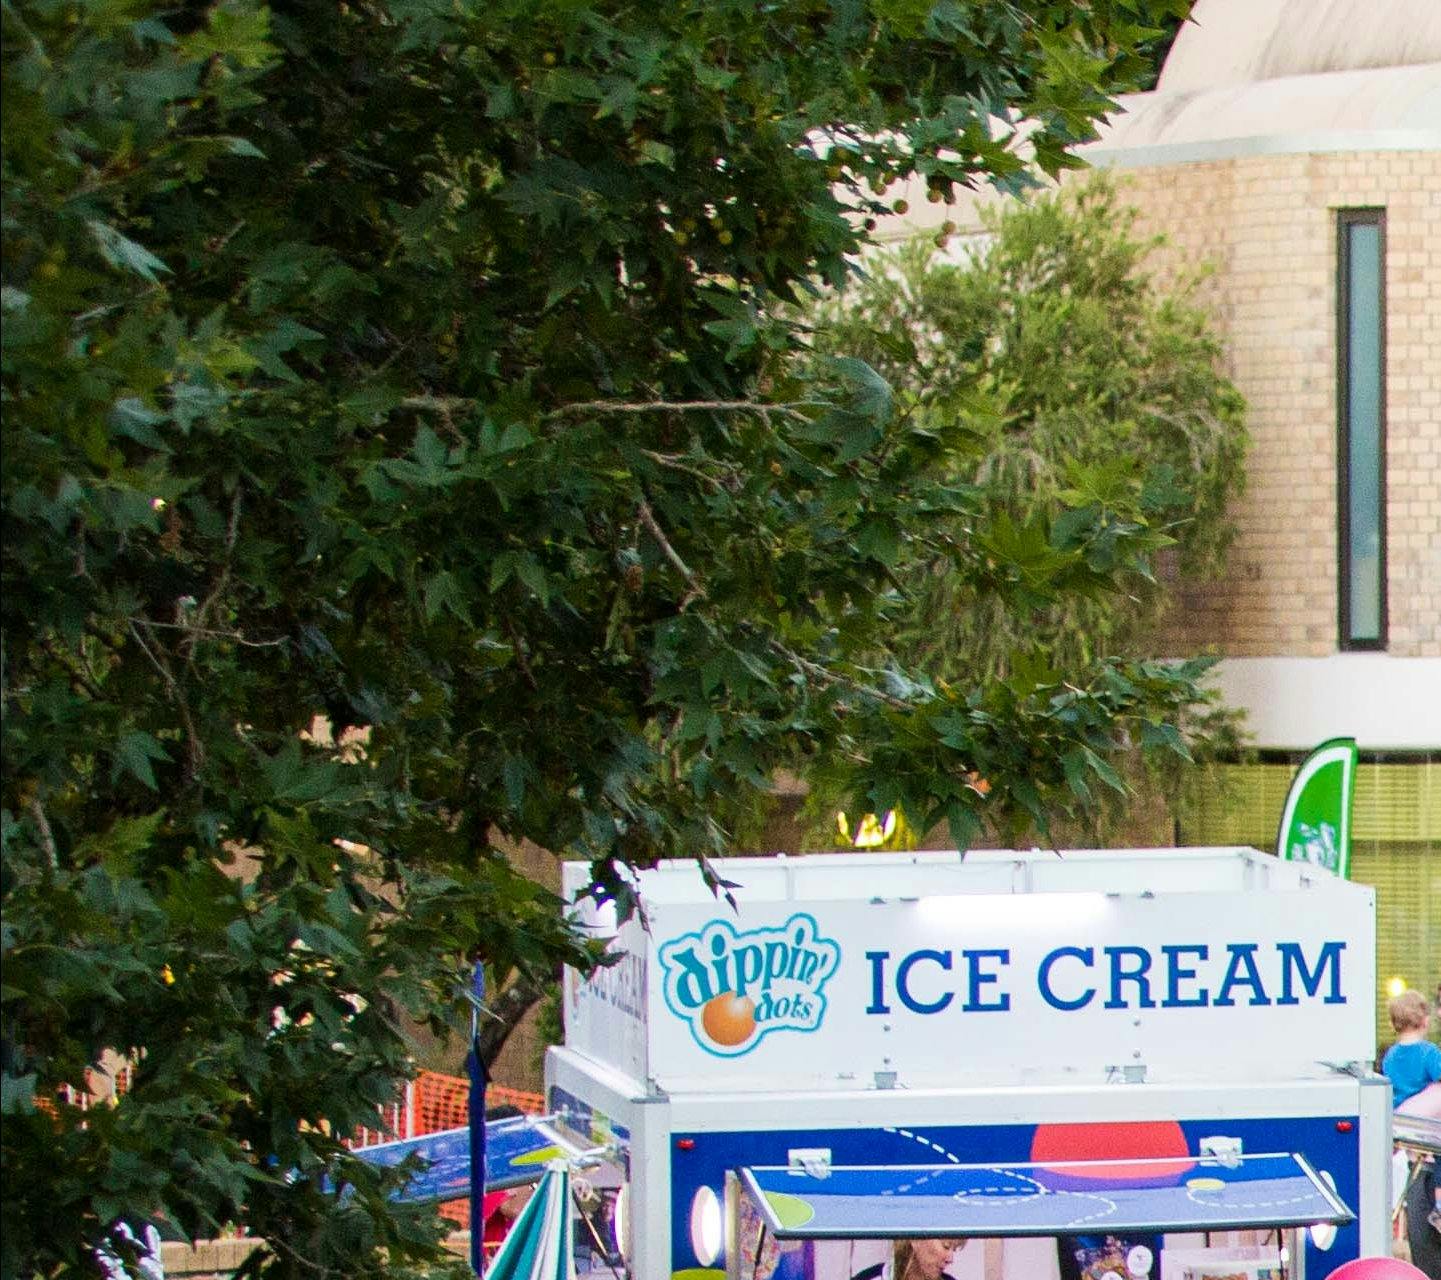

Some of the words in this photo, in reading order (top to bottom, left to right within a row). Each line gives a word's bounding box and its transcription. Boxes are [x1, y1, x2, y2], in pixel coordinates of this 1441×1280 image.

[866, 949, 1011, 1014] ICE
[1037, 942, 1347, 1011] CREAM
[754, 992, 812, 1023] dots
